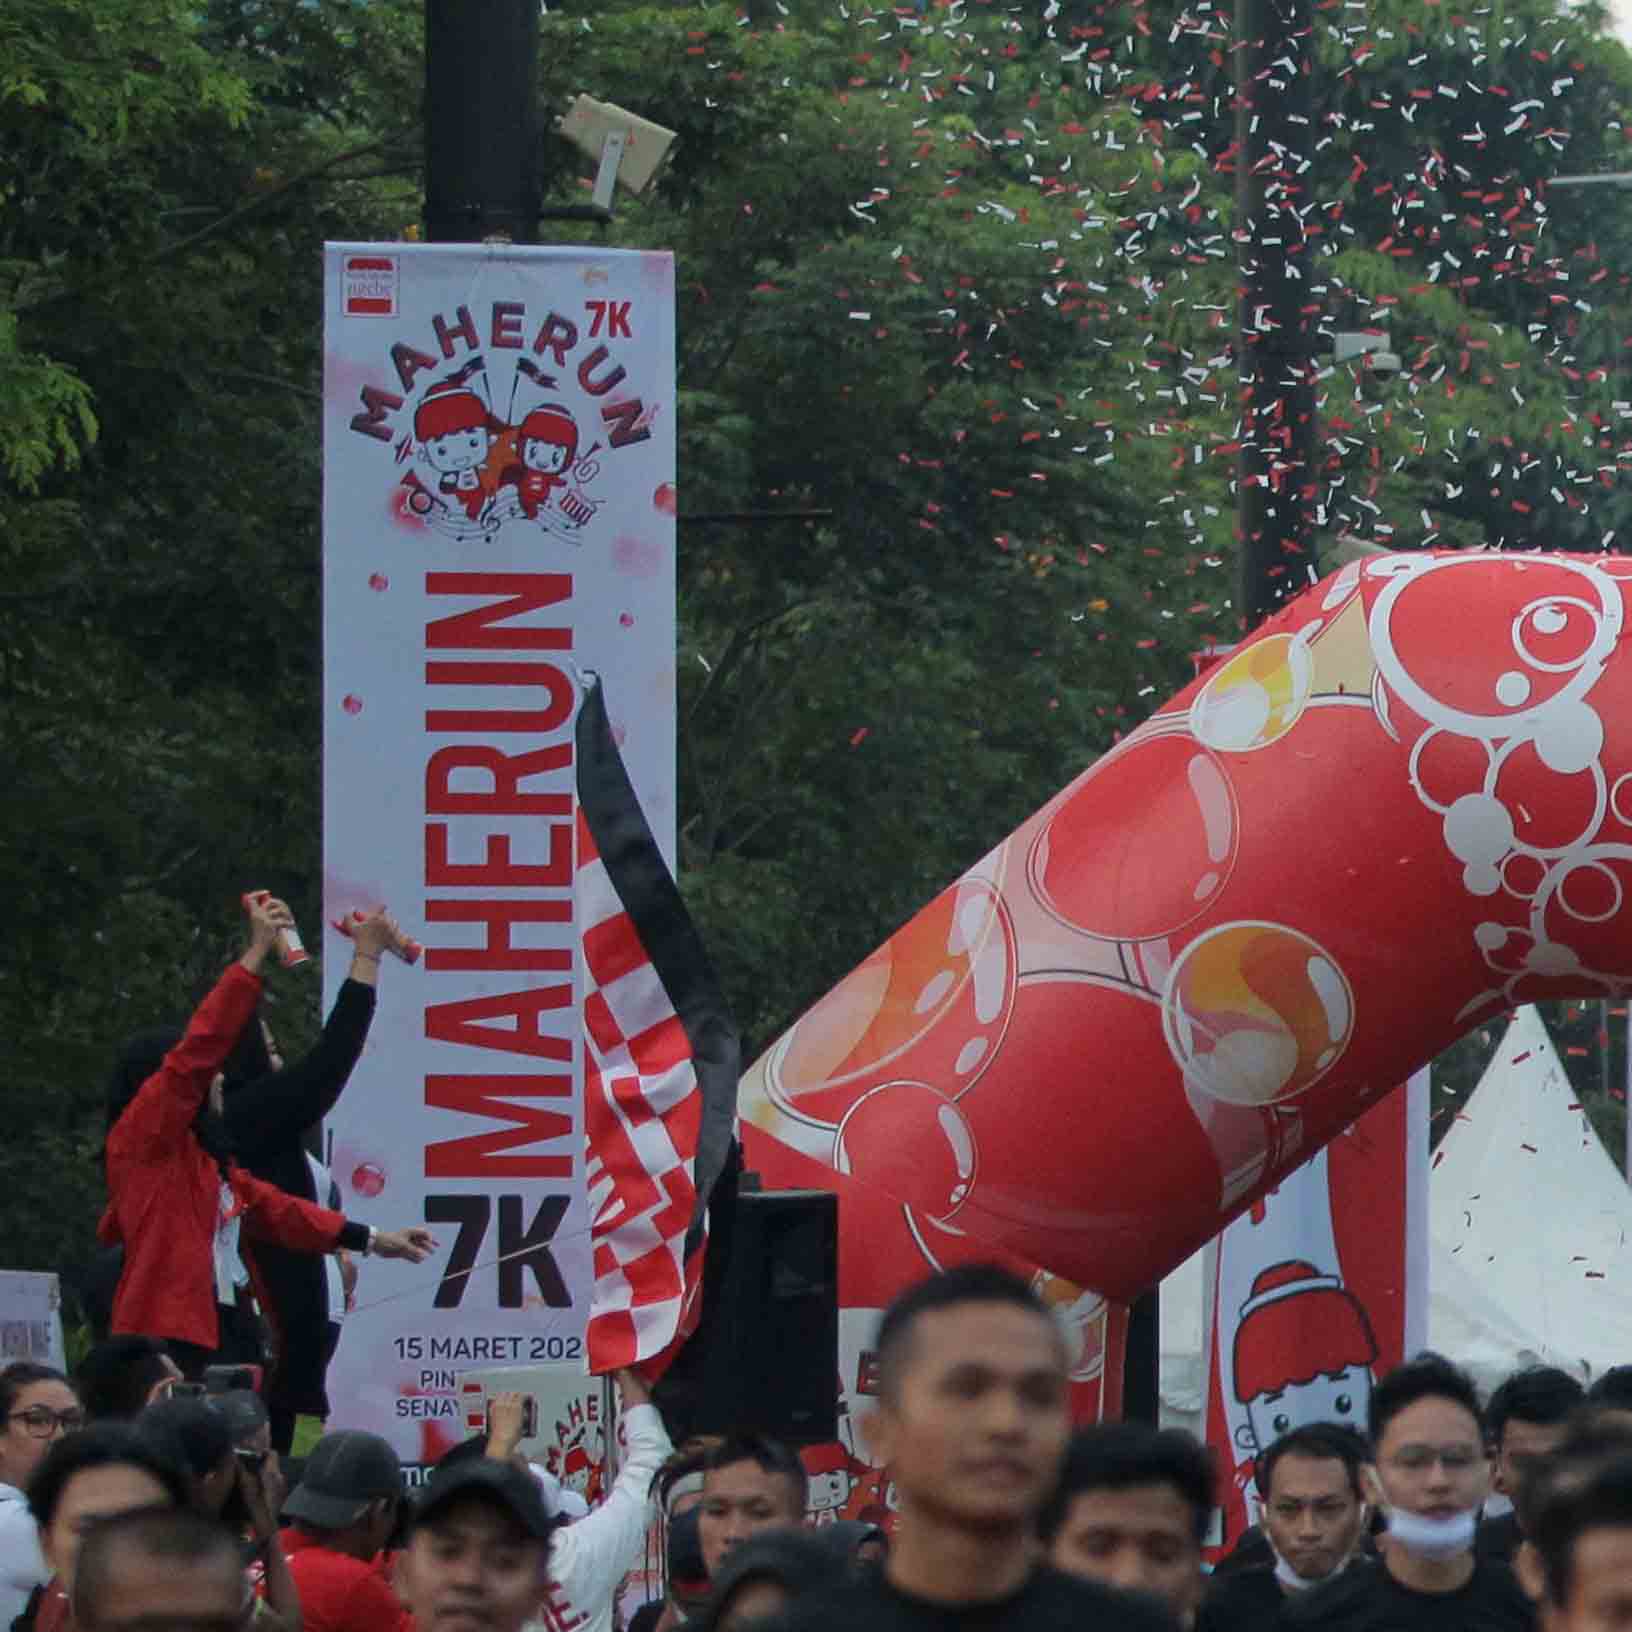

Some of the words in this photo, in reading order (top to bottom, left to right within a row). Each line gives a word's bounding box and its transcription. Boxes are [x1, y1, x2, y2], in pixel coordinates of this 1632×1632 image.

[350, 302, 651, 449] MAHERUN
[585, 301, 632, 338] 7K
[424, 572, 573, 1178] MAHERUN
[424, 1195, 573, 1309] 7K
[394, 1337, 423, 1359] 15
[430, 1337, 523, 1359] MARET
[529, 1337, 583, 1359] 202
